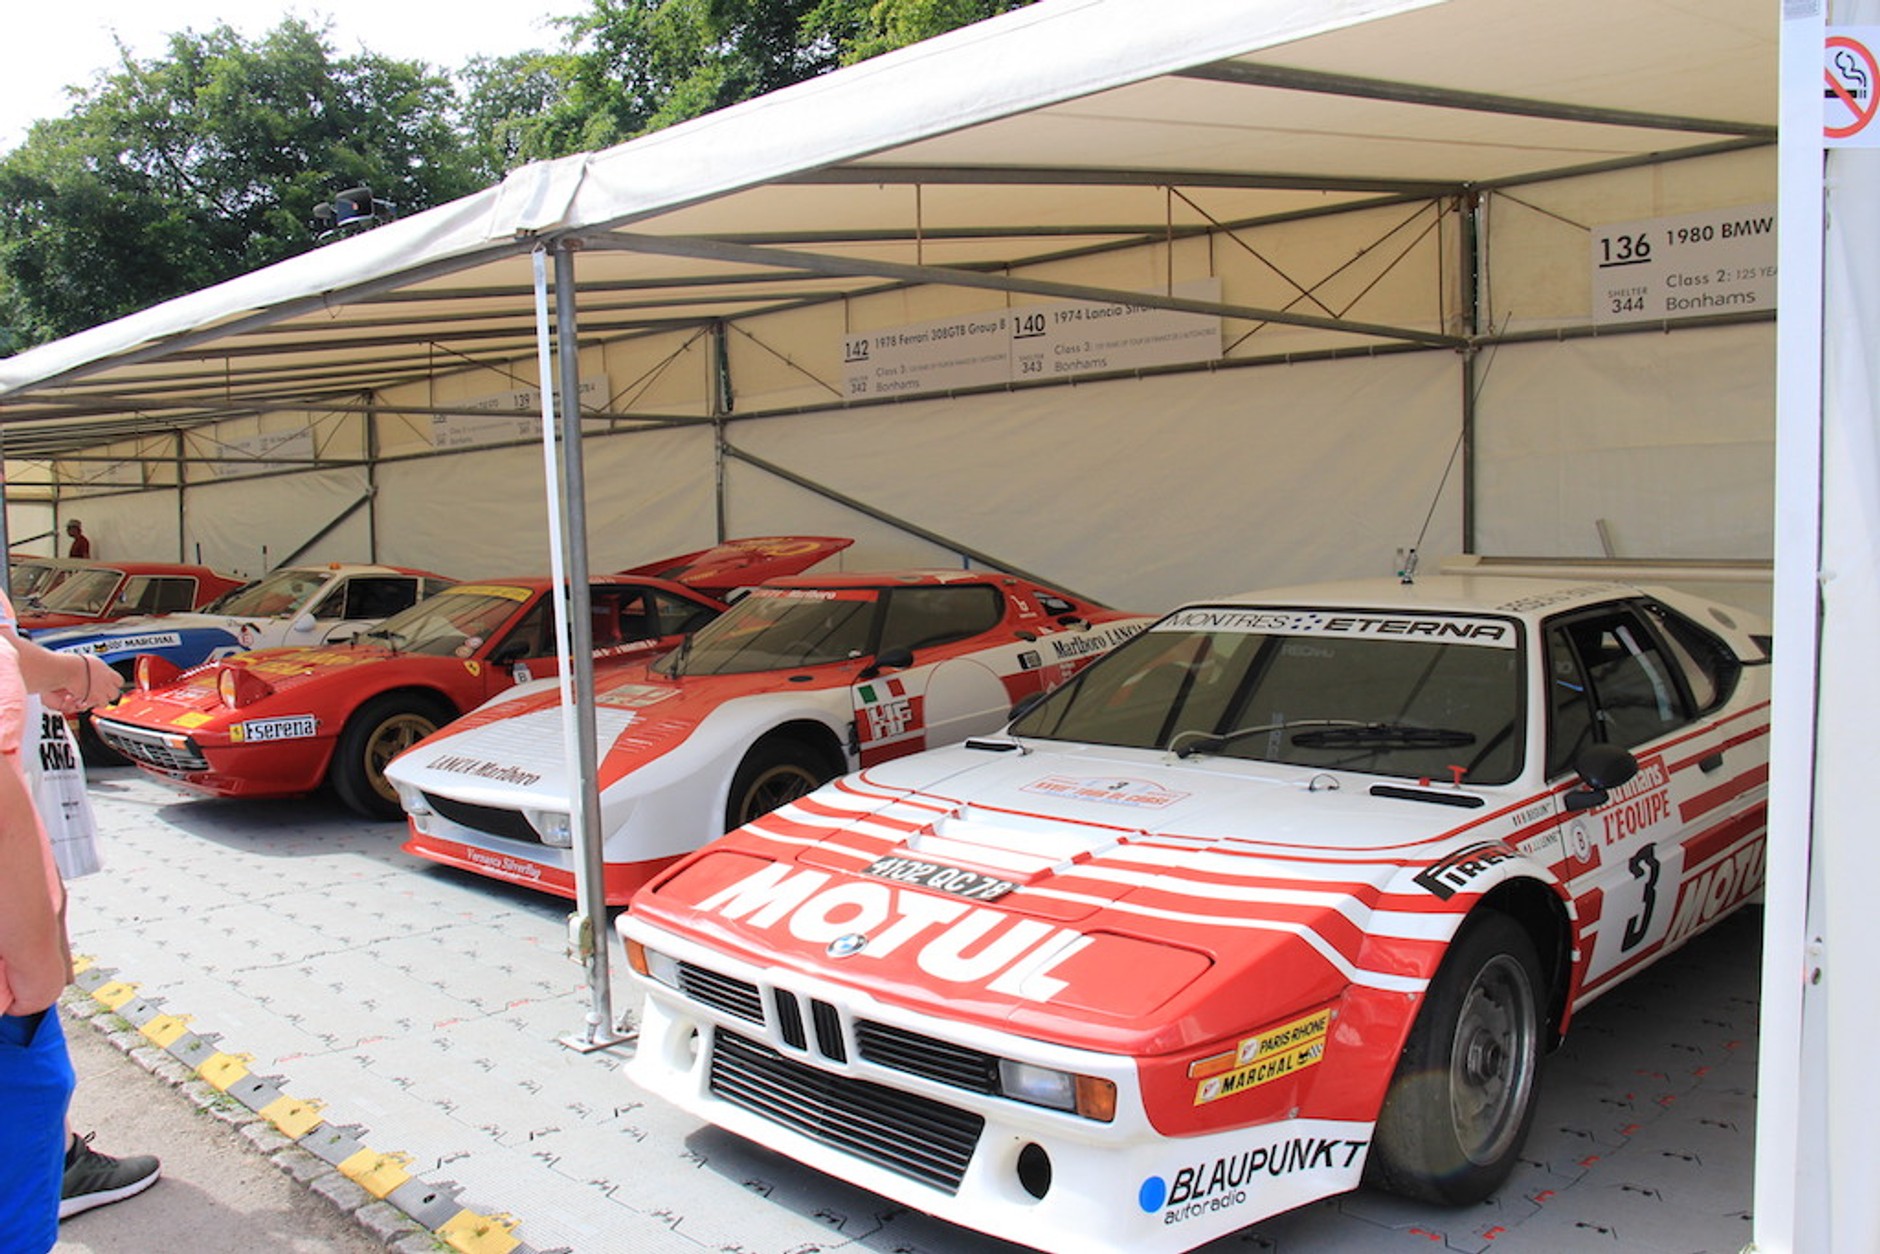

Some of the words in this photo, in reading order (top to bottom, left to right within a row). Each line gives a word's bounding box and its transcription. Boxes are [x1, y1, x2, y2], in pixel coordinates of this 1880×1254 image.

[1667, 225, 1714, 245] 1980
[1722, 217, 1773, 238] BMW
[1601, 233, 1651, 261] 136
[1666, 273, 1709, 288] Class
[1717, 269, 1731, 282] 2:
[1736, 269, 1756, 280] 125
[1608, 287, 1648, 297] SHELTER
[1666, 291, 1756, 310] Bonhams
[1054, 309, 1082, 325] 1974
[1085, 305, 1122, 320] Lancia
[1612, 297, 1644, 313] 344
[875, 335, 897, 349] 1978
[968, 321, 998, 336] Group
[1014, 314, 1045, 334] 140
[845, 339, 869, 358] 142
[1055, 345, 1081, 356] Class
[1022, 361, 1042, 374] 343
[1054, 357, 1108, 373] Bonhams
[876, 378, 920, 393] Bonhams
[1167, 610, 1290, 630] MONTRES
[1323, 617, 1507, 641] ETERNA
[124, 634, 175, 647] MARCHAL
[1052, 634, 1107, 659] Marlboro
[517, 671, 528, 682] B
[476, 760, 541, 787] Marlboro
[927, 866, 978, 892] QC
[964, 876, 1013, 899] 78
[1662, 836, 1767, 952] MOTU
[1621, 842, 1661, 953] 3
[691, 861, 1097, 1003] MOTUL
[1260, 1030, 1291, 1054] PARIS
[1220, 1054, 1294, 1094] MARCHAL
[1166, 1138, 1369, 1207] BLAUPUNKT
[1163, 1190, 1248, 1225] autoradio
